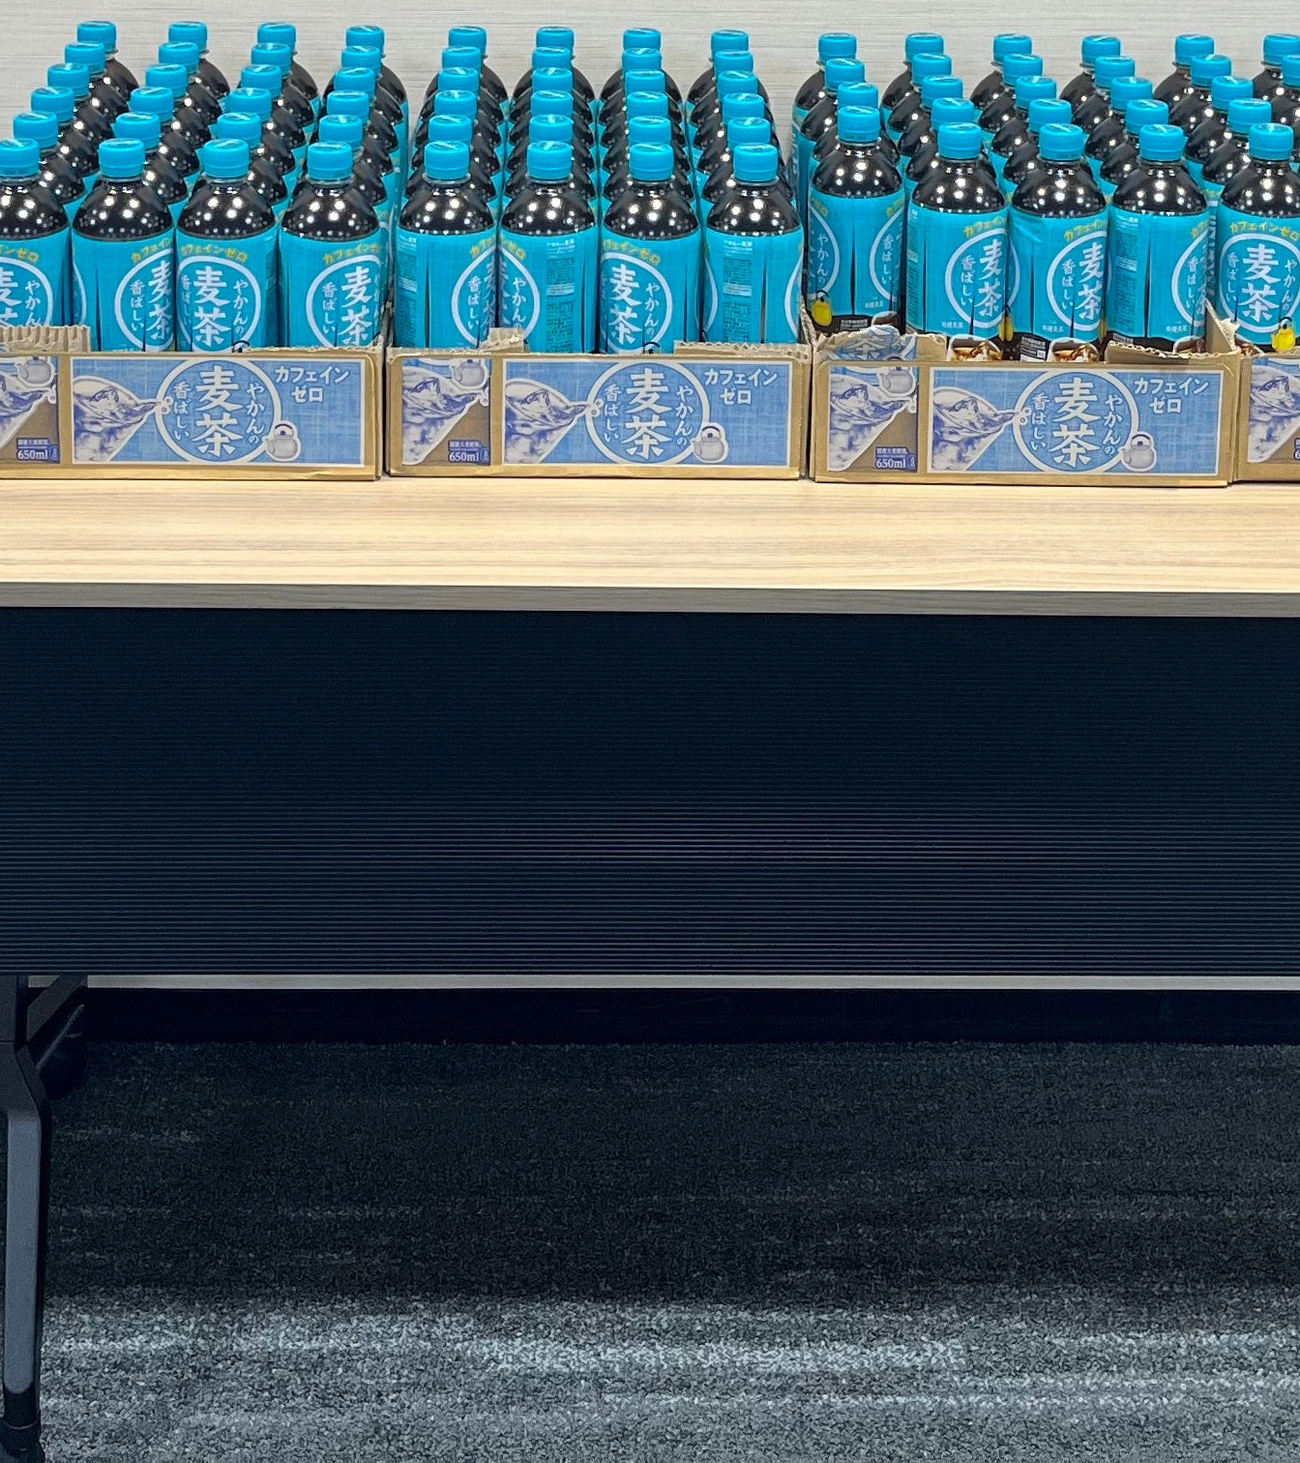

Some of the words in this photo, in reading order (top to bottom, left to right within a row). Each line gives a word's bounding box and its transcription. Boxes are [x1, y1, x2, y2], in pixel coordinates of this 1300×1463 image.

[816, 234, 830, 285] やかんの
[881, 234, 894, 285] 香ばしい
[960, 254, 976, 305] 香ばしい
[975, 239, 1004, 318] 麦茶
[1061, 259, 1076, 309] 香ばしい
[1075, 241, 1105, 320] 麦茶
[1185, 257, 1199, 309] 香ばしい
[1226, 252, 1239, 302] 香ばしい
[1238, 243, 1281, 323] 麦茶
[1281, 258, 1298, 311] やかんの
[24, 280, 41, 326] やかん
[129, 279, 146, 331] 香ばしい
[192, 265, 232, 348] 麦茶
[233, 280, 249, 335] やかんの
[321, 282, 336, 334] 香ばしい
[337, 266, 373, 346] 麦茶
[467, 275, 481, 330] 香ばしい
[609, 263, 642, 344] 麦茶
[644, 282, 660, 335] やかんの
[274, 365, 350, 386] カフェイン
[291, 387, 324, 405] ゼロ
[703, 367, 779, 387] カフェイン
[719, 389, 752, 406] ゼロ
[1133, 376, 1210, 396] カフェイン
[171, 381, 191, 442] 香ばしい
[194, 365, 242, 458] 麦茶
[245, 382, 266, 445] やかんの
[602, 382, 621, 444] 香ばしい
[624, 368, 673, 459] 麦茶
[674, 383, 694, 447] やかんの
[1030, 392, 1050, 452] 香ばしい
[1052, 377, 1100, 468] 麦茶
[1102, 393, 1124, 455] やかんの
[1149, 397, 1182, 415] ゼロ
[17, 448, 48, 460] 650ml
[449, 451, 479, 462] 650ml
[875, 458, 906, 469] 650ml
